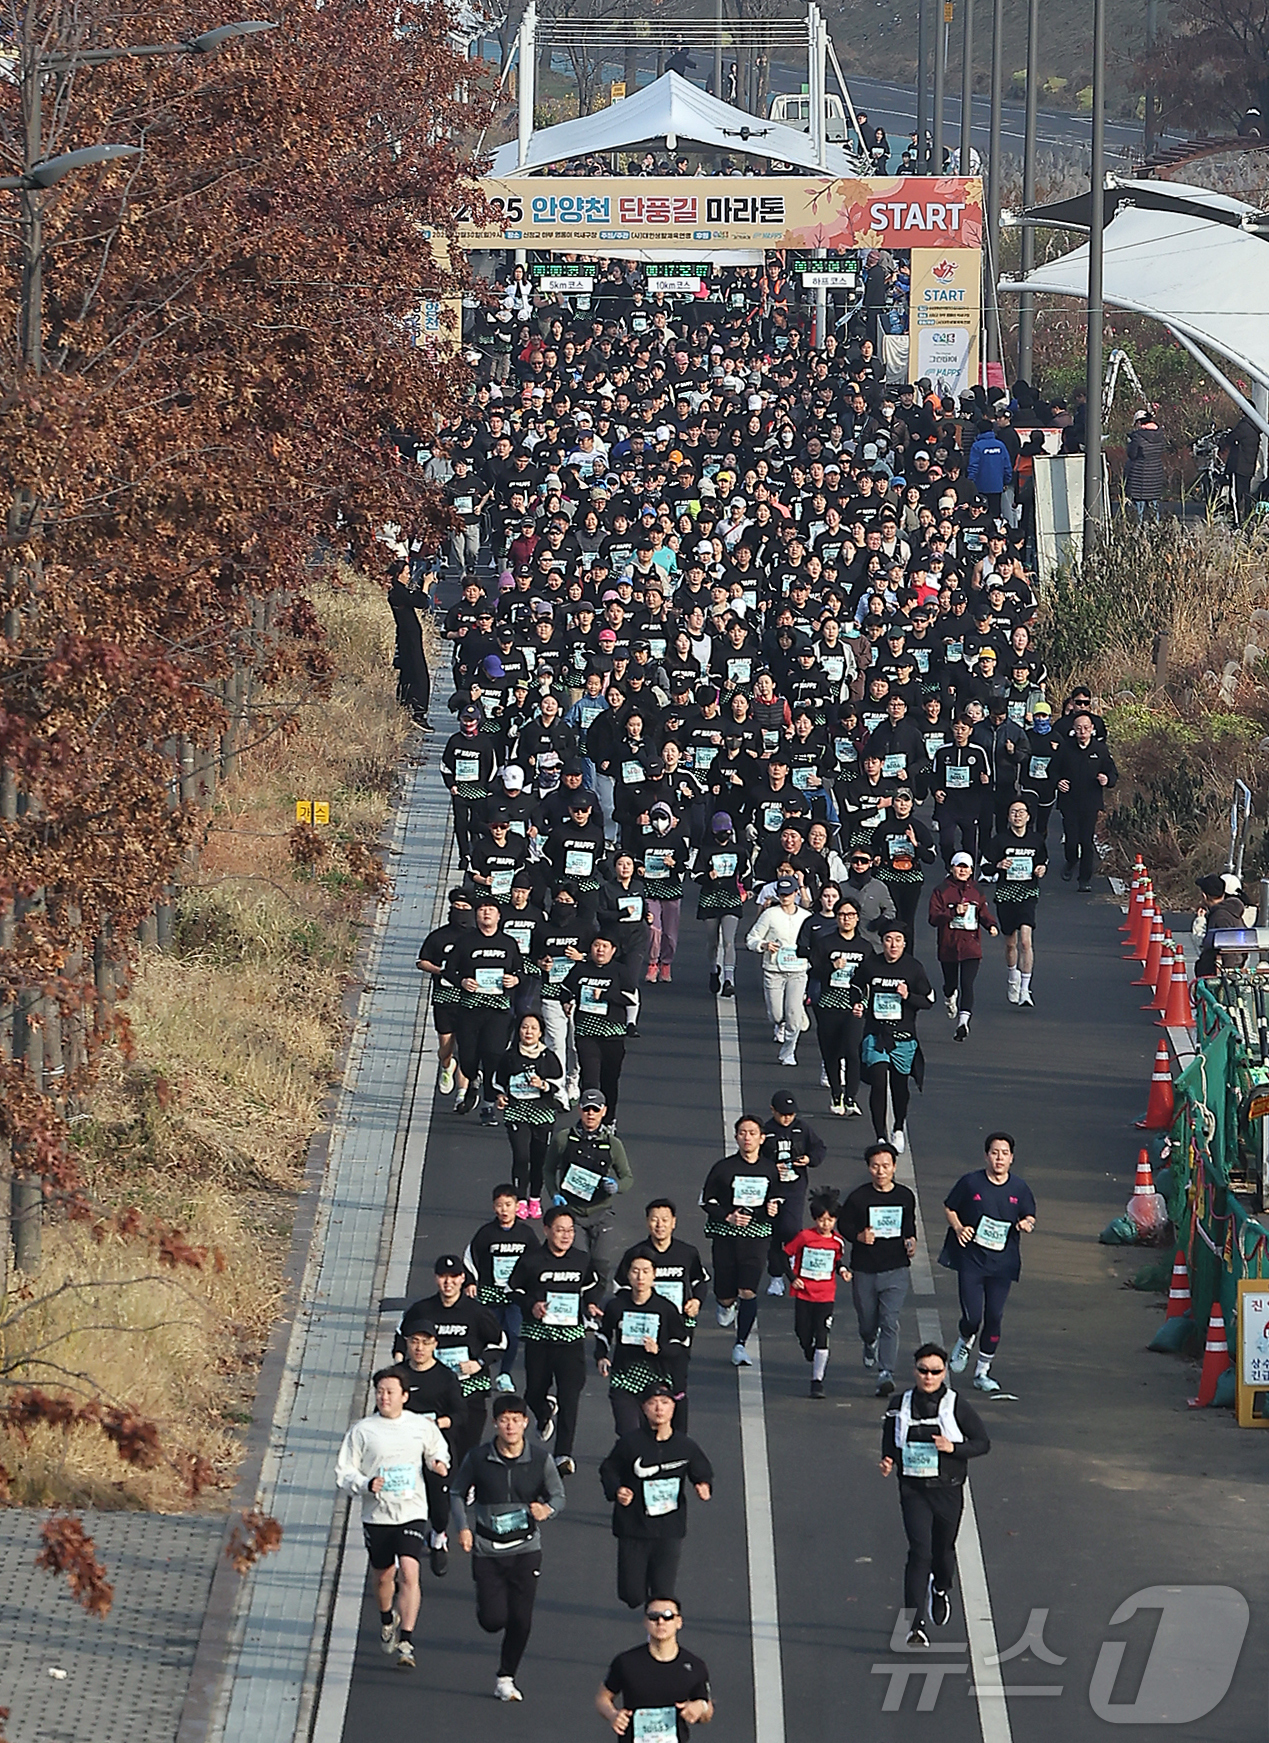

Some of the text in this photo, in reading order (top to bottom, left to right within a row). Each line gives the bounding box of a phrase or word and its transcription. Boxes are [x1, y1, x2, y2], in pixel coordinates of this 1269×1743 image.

[532, 196, 610, 223] 안양천
[619, 197, 697, 223] 단풍길
[706, 197, 784, 223] 마라톤
[870, 202, 965, 231] START
[924, 290, 965, 301] START
[300, 807, 326, 818] 가스
[574, 841, 596, 850] HAPPS
[1015, 848, 1036, 857] HAPPS
[496, 857, 516, 866] HAPPS
[514, 920, 536, 929] HAPPS
[556, 938, 578, 946] HAPPS
[482, 950, 506, 958] HAPPS
[588, 978, 612, 988] HAPPS
[500, 1244, 526, 1254] HAPPS
[552, 1271, 581, 1282] HAPPS
[438, 1325, 468, 1336] HAPPS
